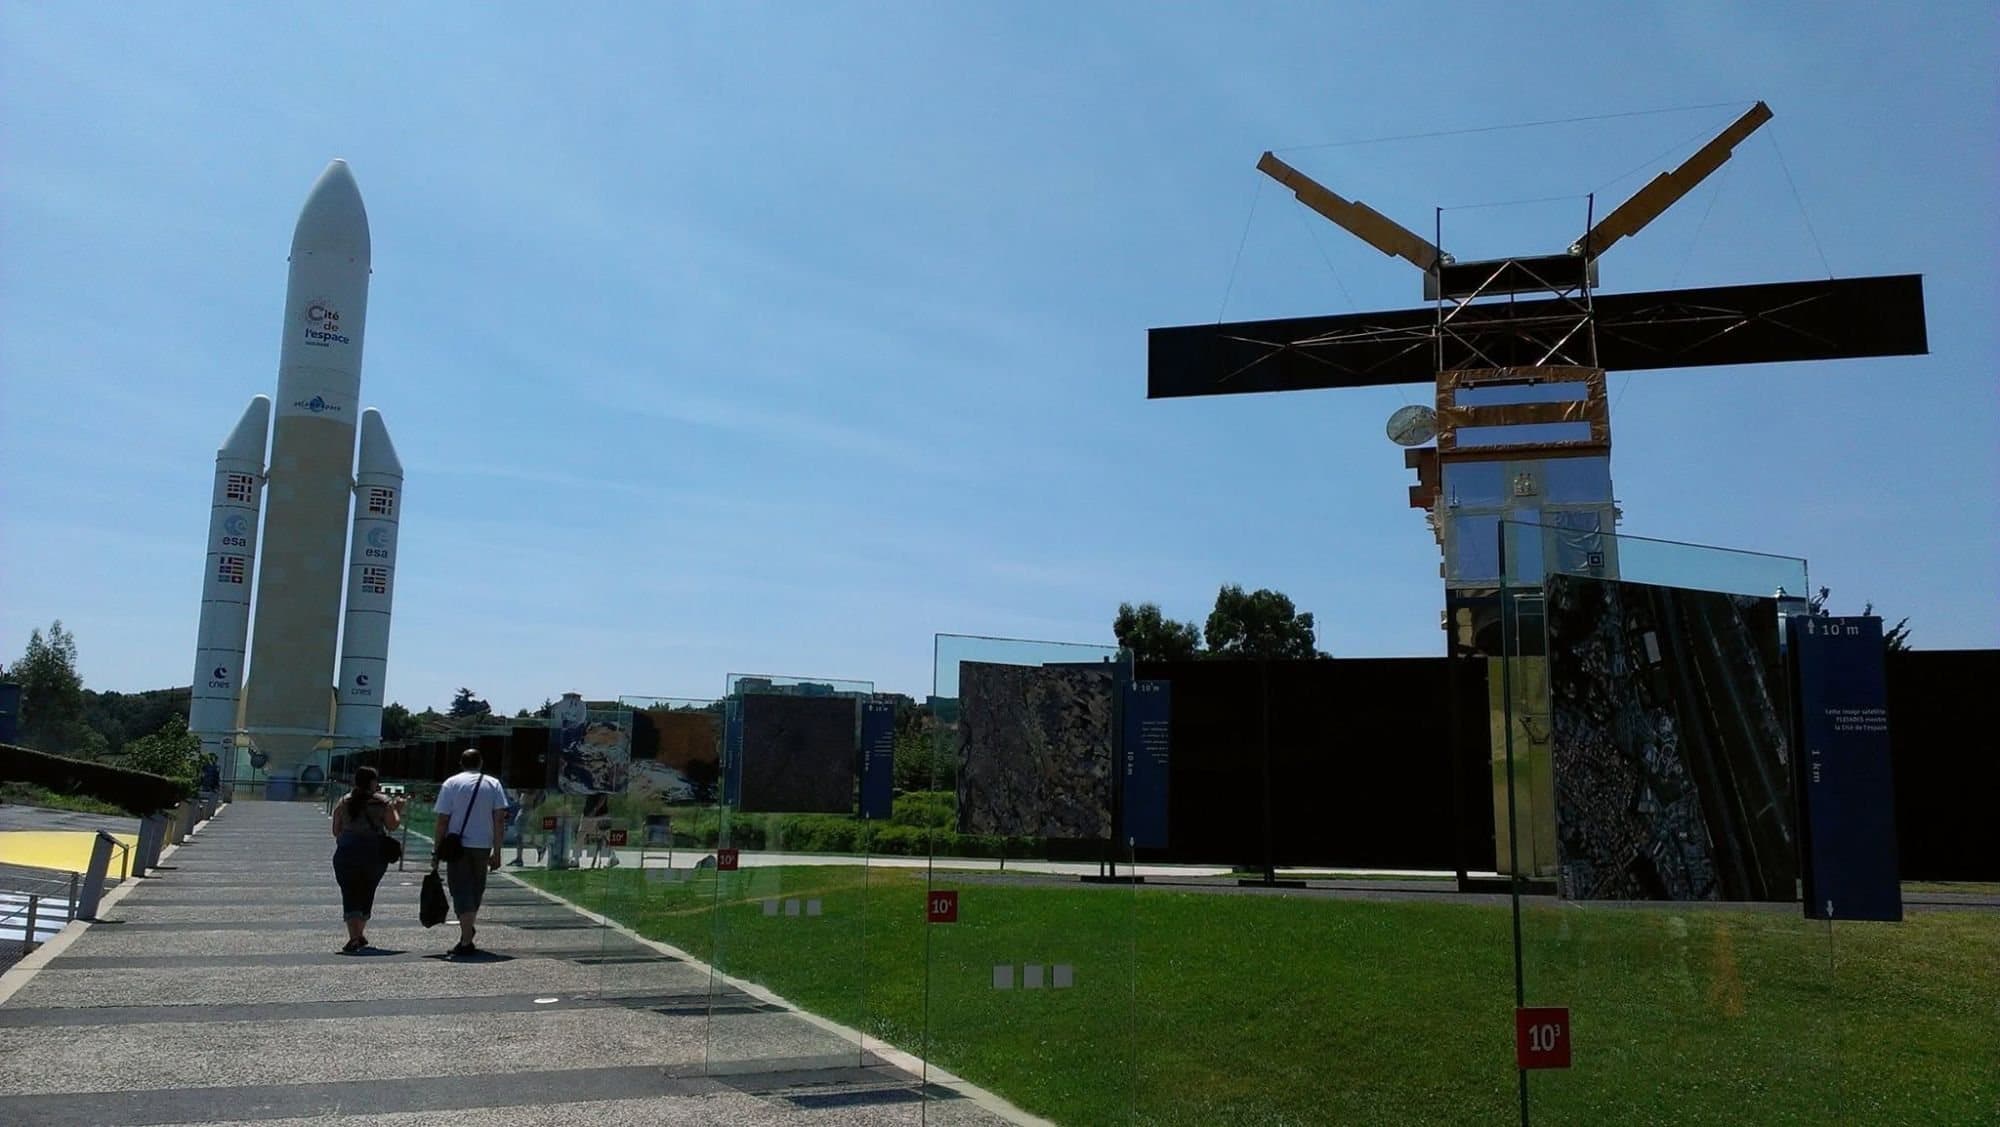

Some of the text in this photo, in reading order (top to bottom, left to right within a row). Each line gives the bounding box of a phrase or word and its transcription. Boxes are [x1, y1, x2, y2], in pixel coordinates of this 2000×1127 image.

[308, 305, 340, 320] Cité
[323, 320, 339, 331] de
[305, 328, 350, 344] l'espace
[222, 536, 247, 547] esa
[365, 548, 388, 559] esa
[1847, 625, 1859, 636] m
